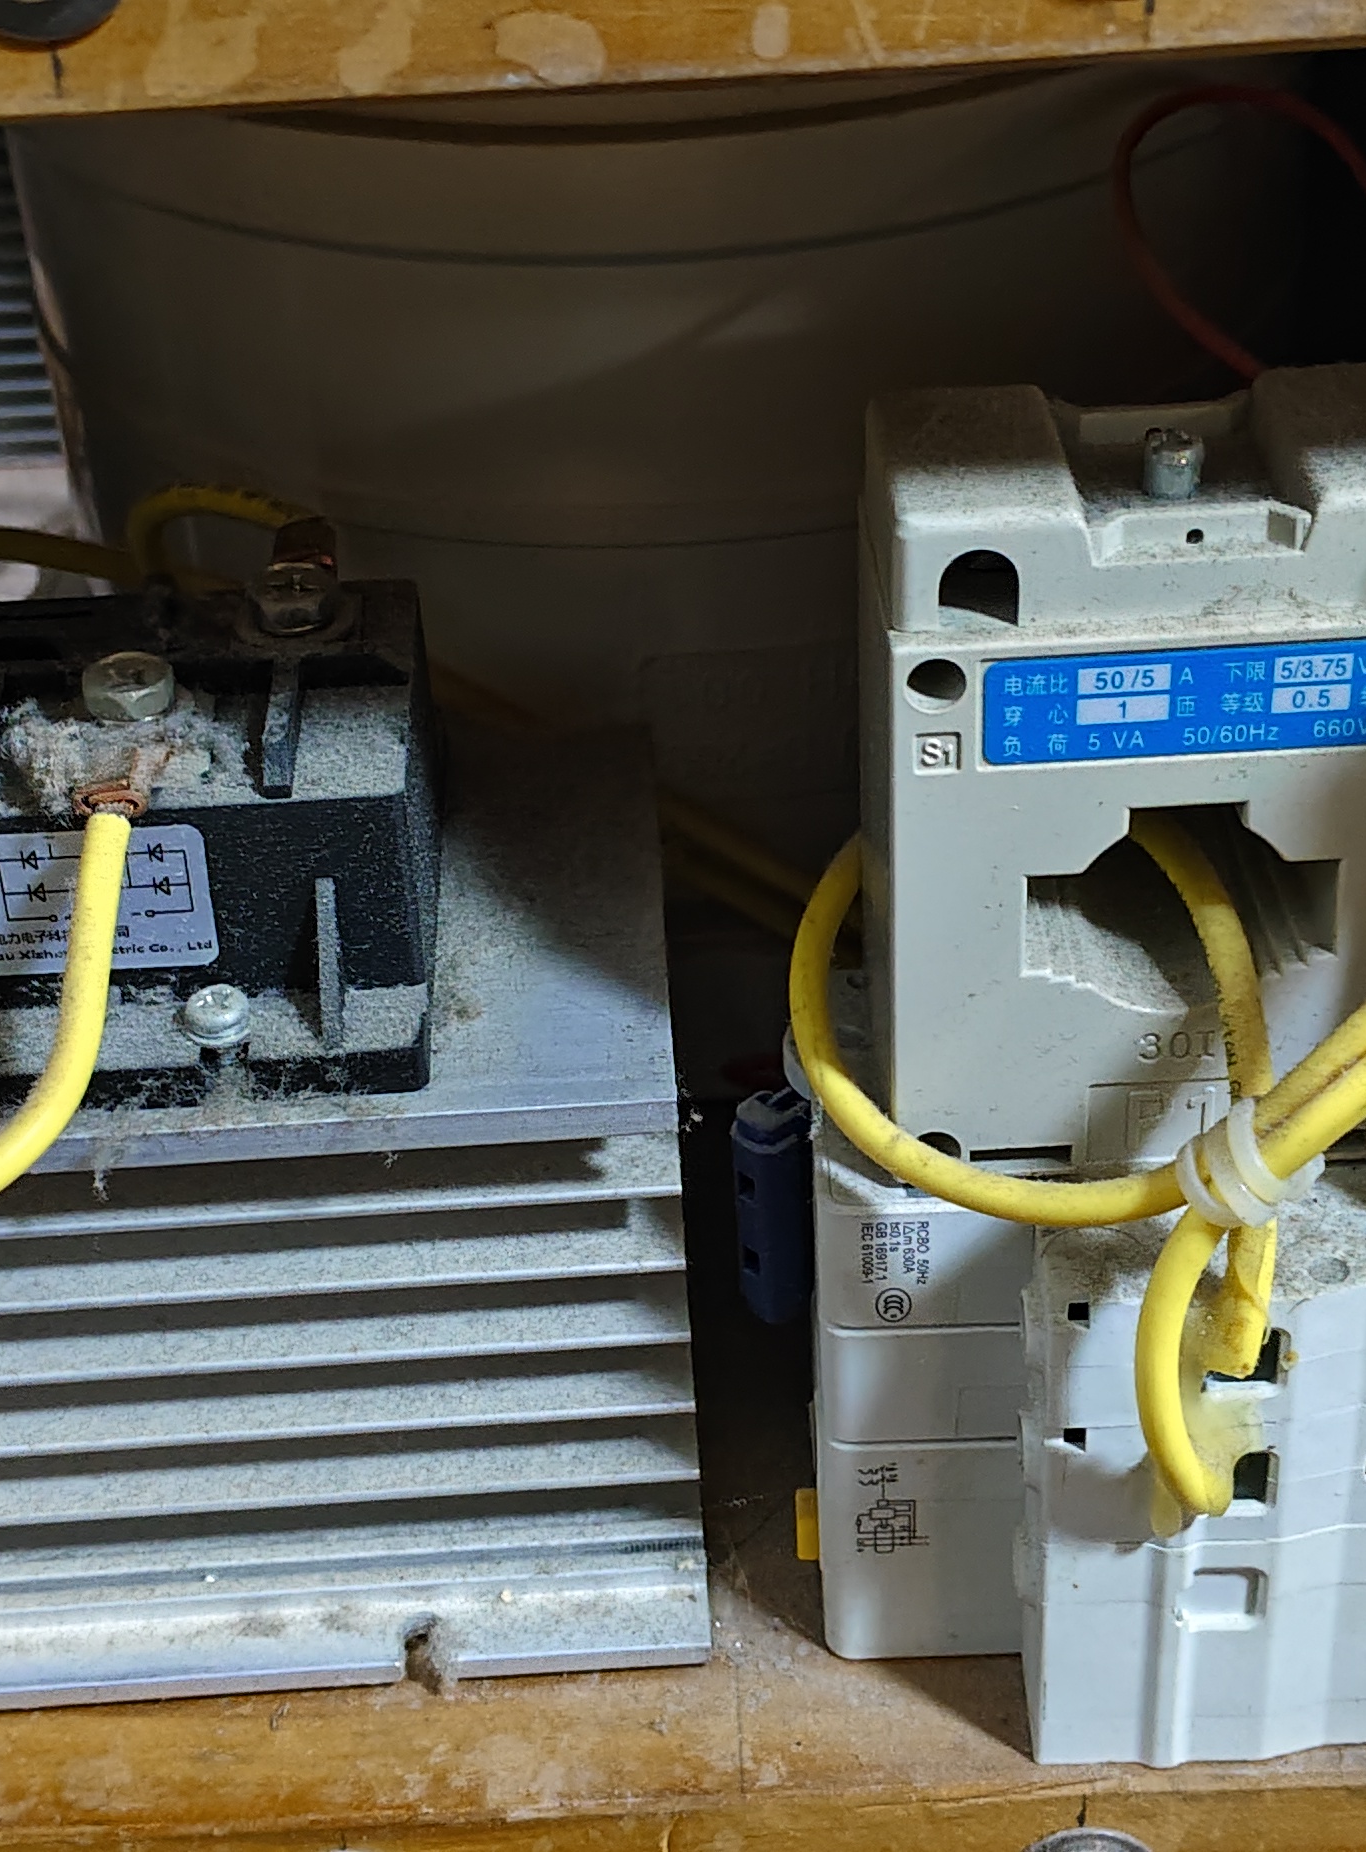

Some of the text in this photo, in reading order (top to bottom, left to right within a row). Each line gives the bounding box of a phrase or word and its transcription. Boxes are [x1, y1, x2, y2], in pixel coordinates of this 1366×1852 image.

[1003, 673, 1069, 697] 电流比
[1178, 666, 1194, 686] A
[1224, 660, 1266, 683] 下限
[1280, 657, 1348, 680] 5/3.75
[1118, 701, 1129, 719] 1
[1221, 692, 1264, 715] 等级
[1291, 689, 1332, 709] 0.5
[1088, 734, 1101, 751] 5
[1112, 730, 1145, 749] VA
[1182, 724, 1280, 746] 50/60Hz
[187, 940, 212, 951] Ltd
[861, 1222, 874, 1242] IEC
[875, 1221, 888, 1281] GB 16917.1
[902, 1247, 916, 1274] 630A
[916, 1220, 930, 1285] RCBO 50Hz
